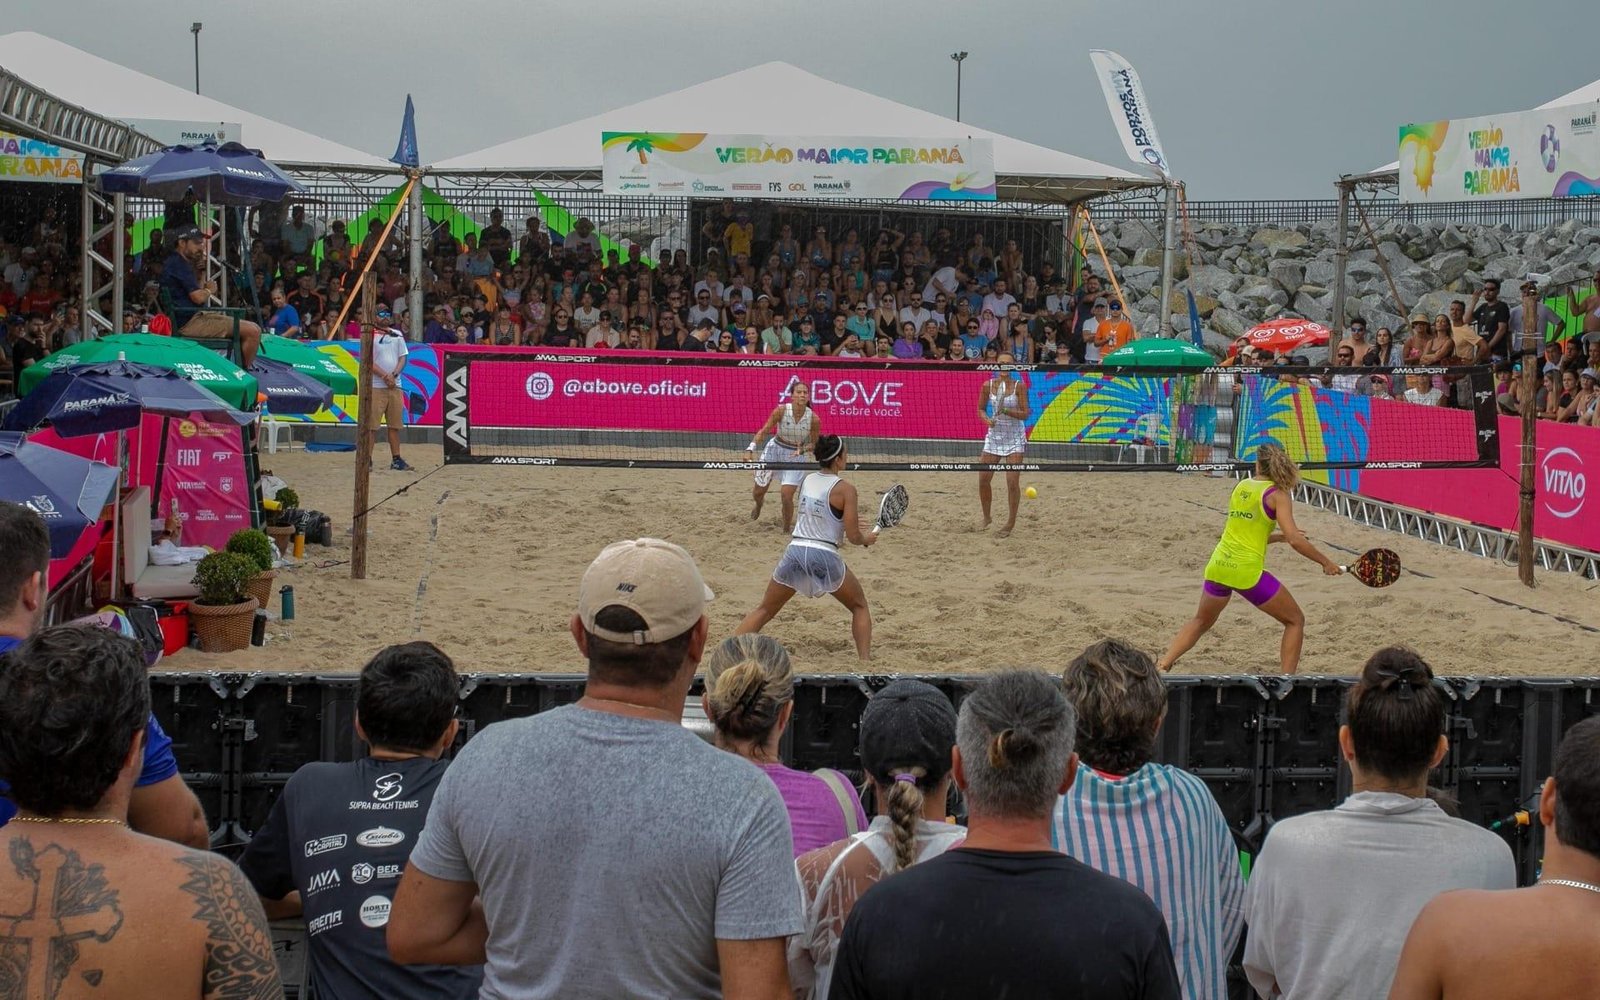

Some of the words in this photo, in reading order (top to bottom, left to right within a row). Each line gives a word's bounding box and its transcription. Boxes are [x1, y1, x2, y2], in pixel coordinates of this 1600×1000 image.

[0, 138, 60, 156] AIOR
[715, 143, 794, 164] VERÃO
[797, 148, 869, 164] MAIOR
[872, 145, 964, 164] PARANÁ
[1475, 146, 1510, 168] MAIOR
[1464, 161, 1520, 195] PARANÁ
[768, 182, 782, 192] FYS
[788, 183, 807, 191] GOL
[563, 378, 707, 397] @above.oficial
[446, 365, 467, 448] AMA
[840, 405, 871, 416] sobre
[177, 449, 202, 466] FIAT
[616, 582, 638, 593] NIKE
[349, 801, 371, 810] SUPRA
[371, 802, 394, 810] BEACH
[394, 800, 419, 809] TENNIS
[376, 864, 400, 874] BER
[307, 868, 341, 892] JAYA
[363, 904, 390, 912] HORTI
[309, 909, 343, 933] ARENA
